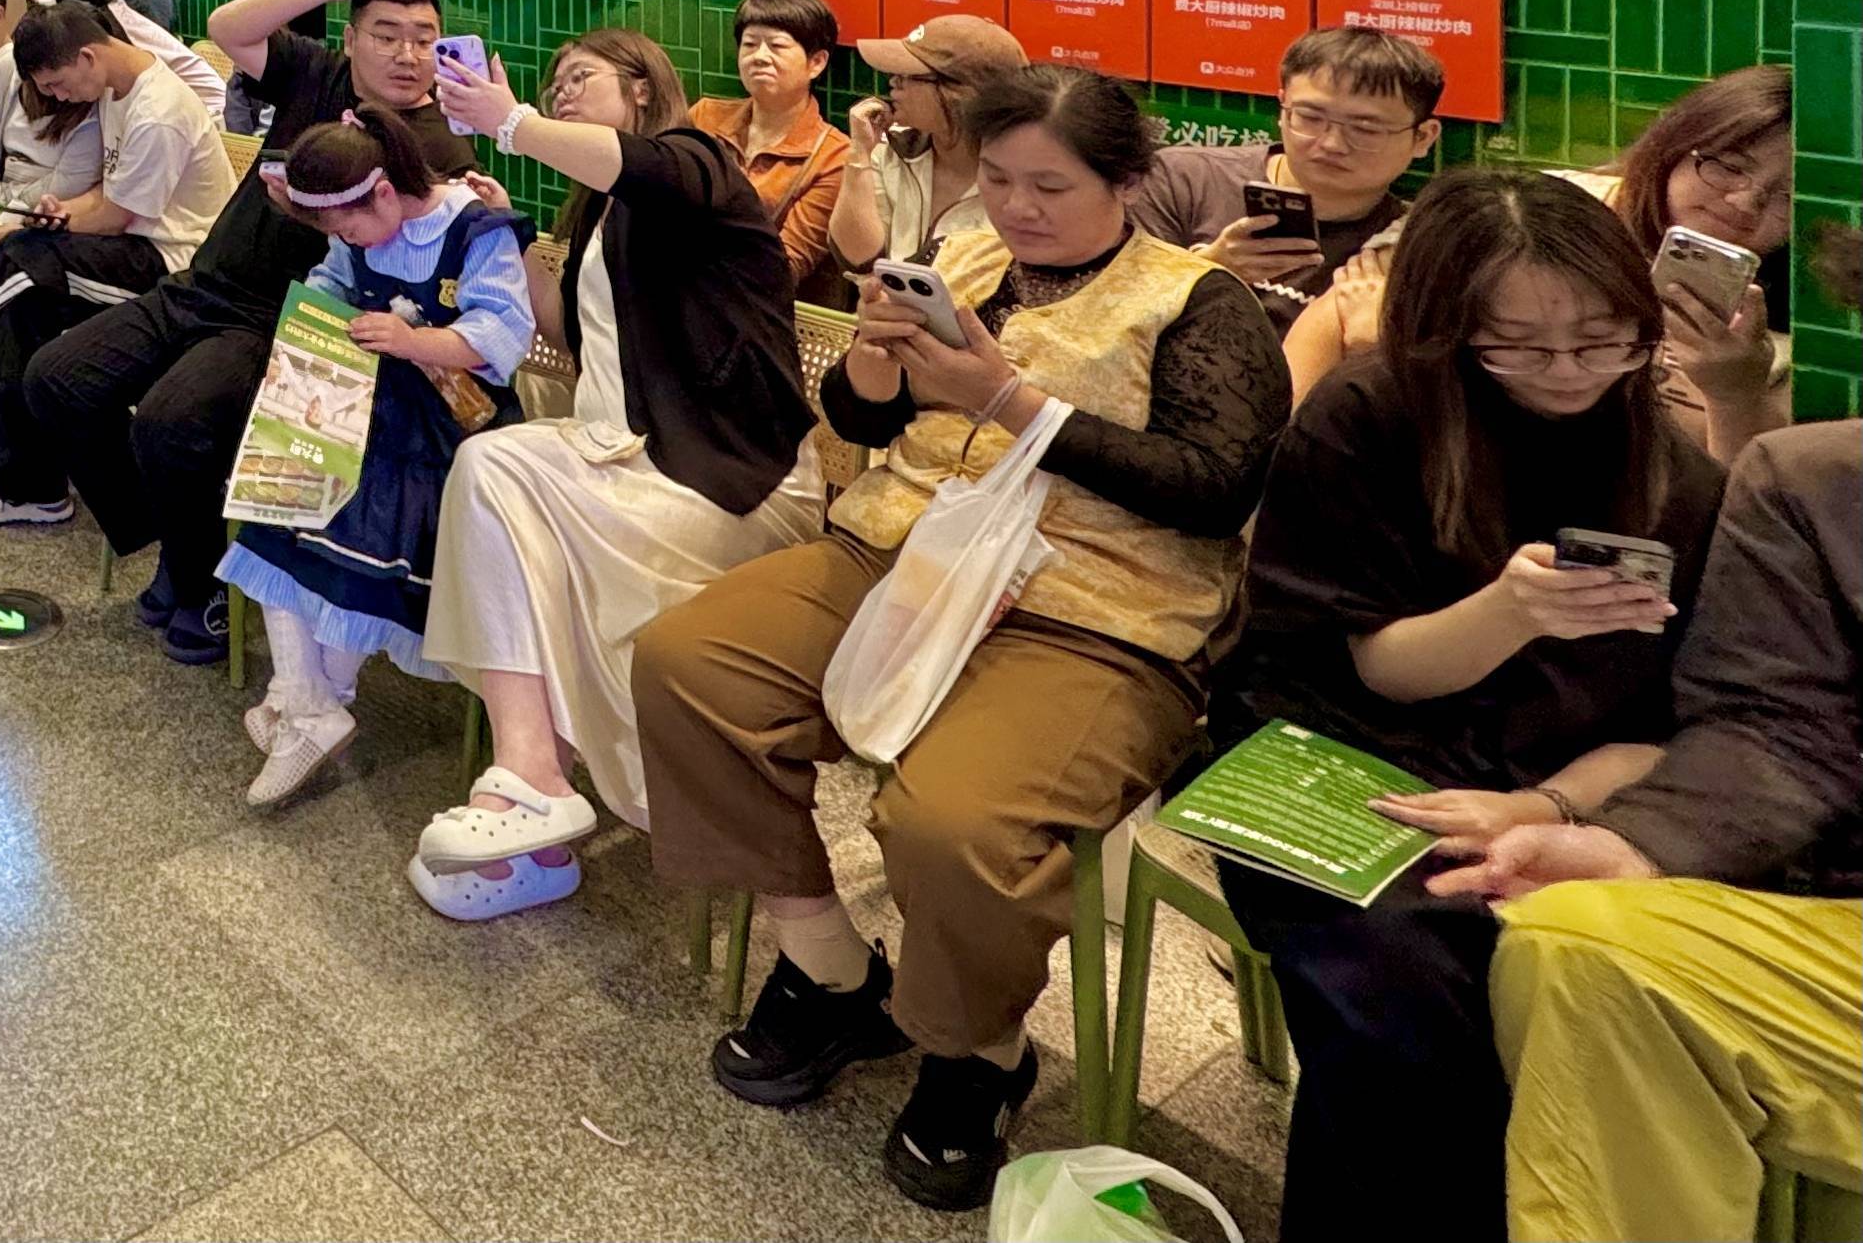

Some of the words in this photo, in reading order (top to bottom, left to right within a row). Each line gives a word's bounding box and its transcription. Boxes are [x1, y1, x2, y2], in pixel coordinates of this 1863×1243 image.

[1344, 11, 1473, 36] 费大厨辣椒炒肉
